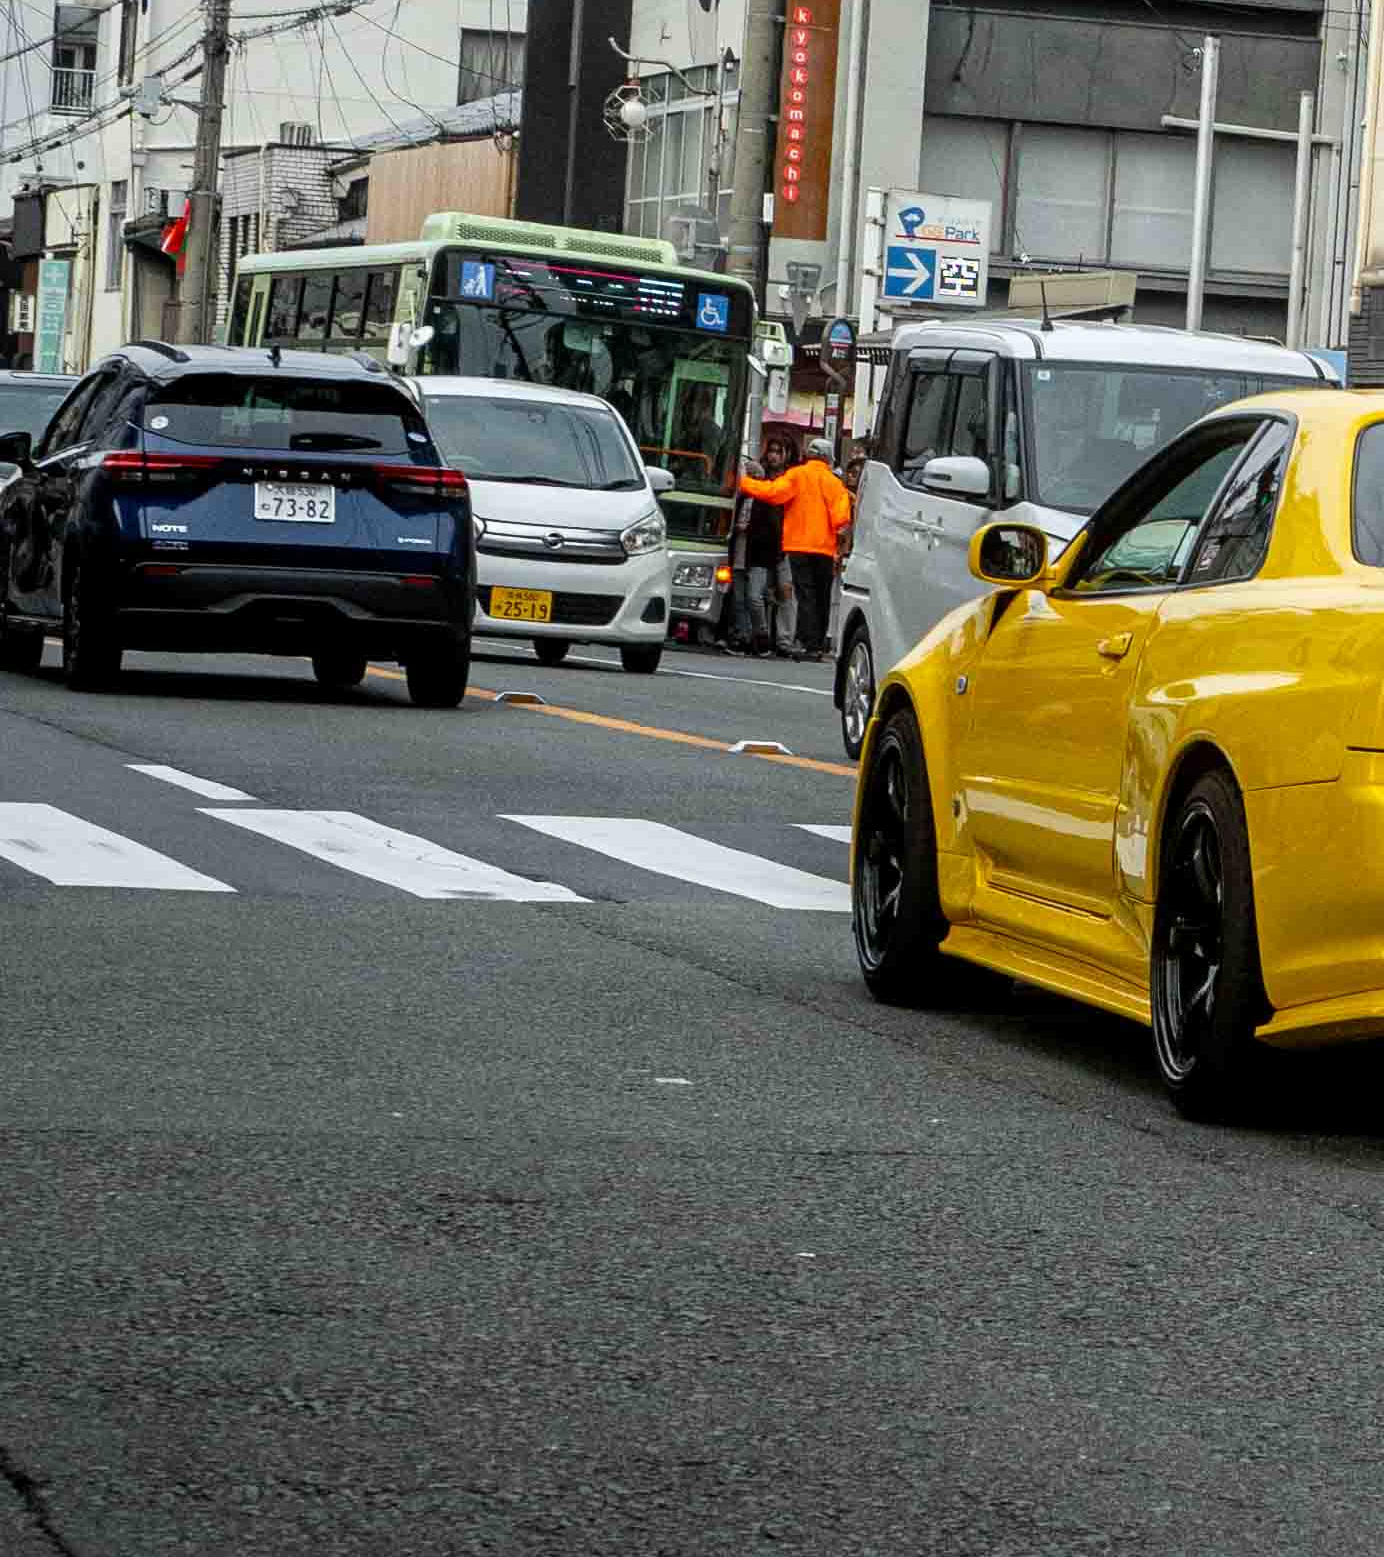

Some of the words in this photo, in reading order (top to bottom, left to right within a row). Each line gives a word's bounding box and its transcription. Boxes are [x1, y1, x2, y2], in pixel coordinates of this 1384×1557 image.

[786, 8, 809, 200] kyokomachi
[272, 496, 330, 520] 73-82
[151, 524, 188, 533] NOTE
